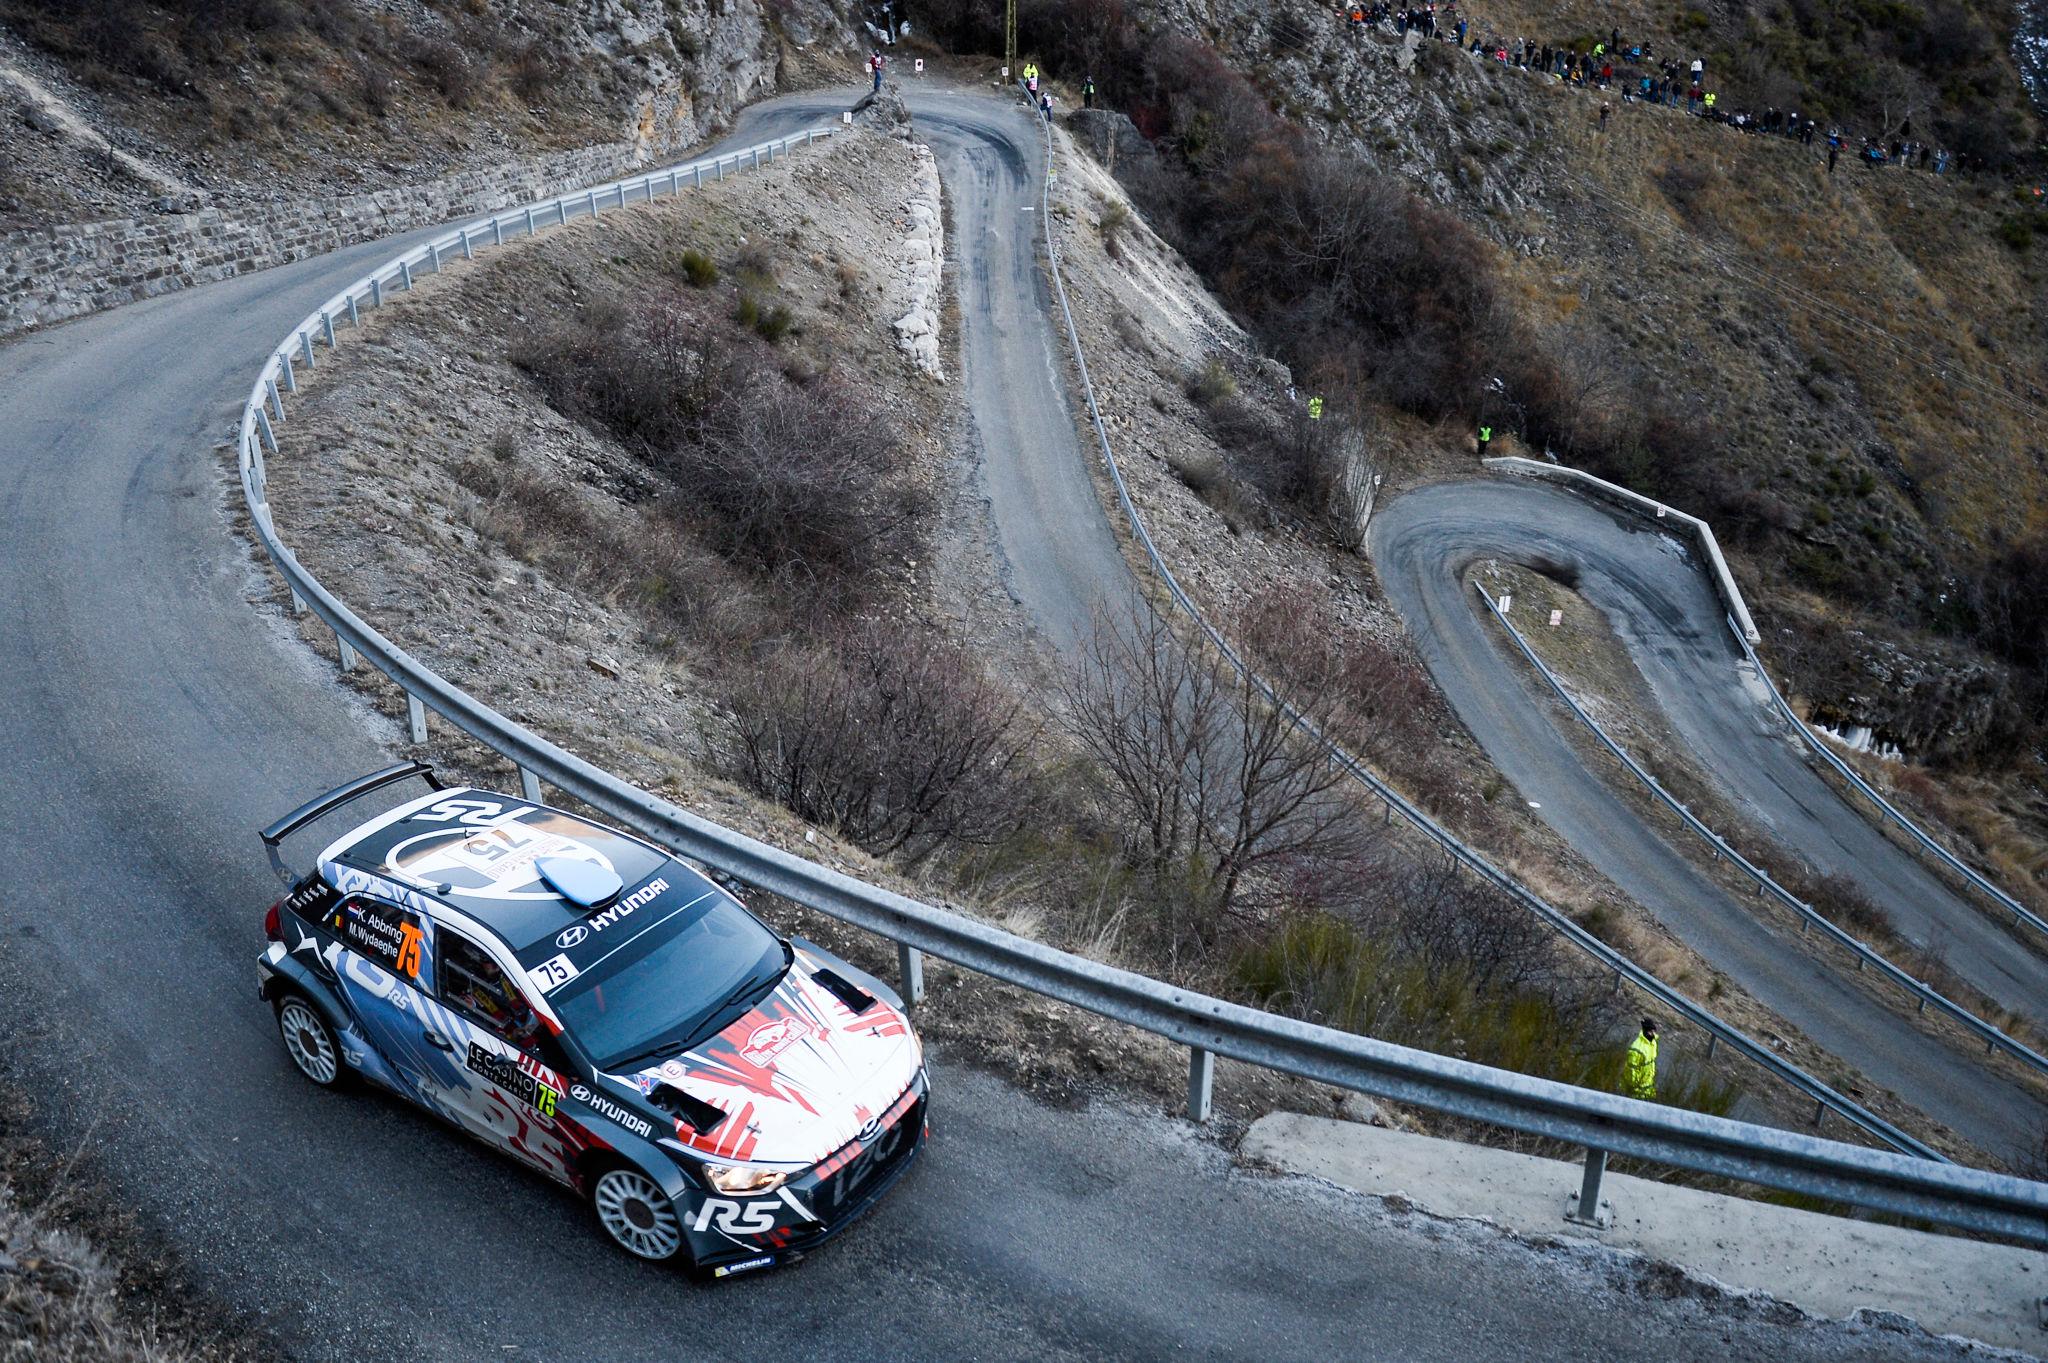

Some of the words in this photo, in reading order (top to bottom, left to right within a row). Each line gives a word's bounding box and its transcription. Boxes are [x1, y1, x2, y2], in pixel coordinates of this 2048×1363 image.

[464, 829, 534, 861] 75
[588, 877, 671, 933] HYUNDAI
[357, 909, 366, 923] K.
[368, 913, 403, 943] Abbring
[397, 922, 424, 978] 75
[538, 959, 569, 987] 75
[470, 1045, 482, 1063] LE
[538, 1085, 556, 1117] 75
[591, 1094, 652, 1138] HYUNDAI
[729, 1257, 771, 1272] MICHELIN
